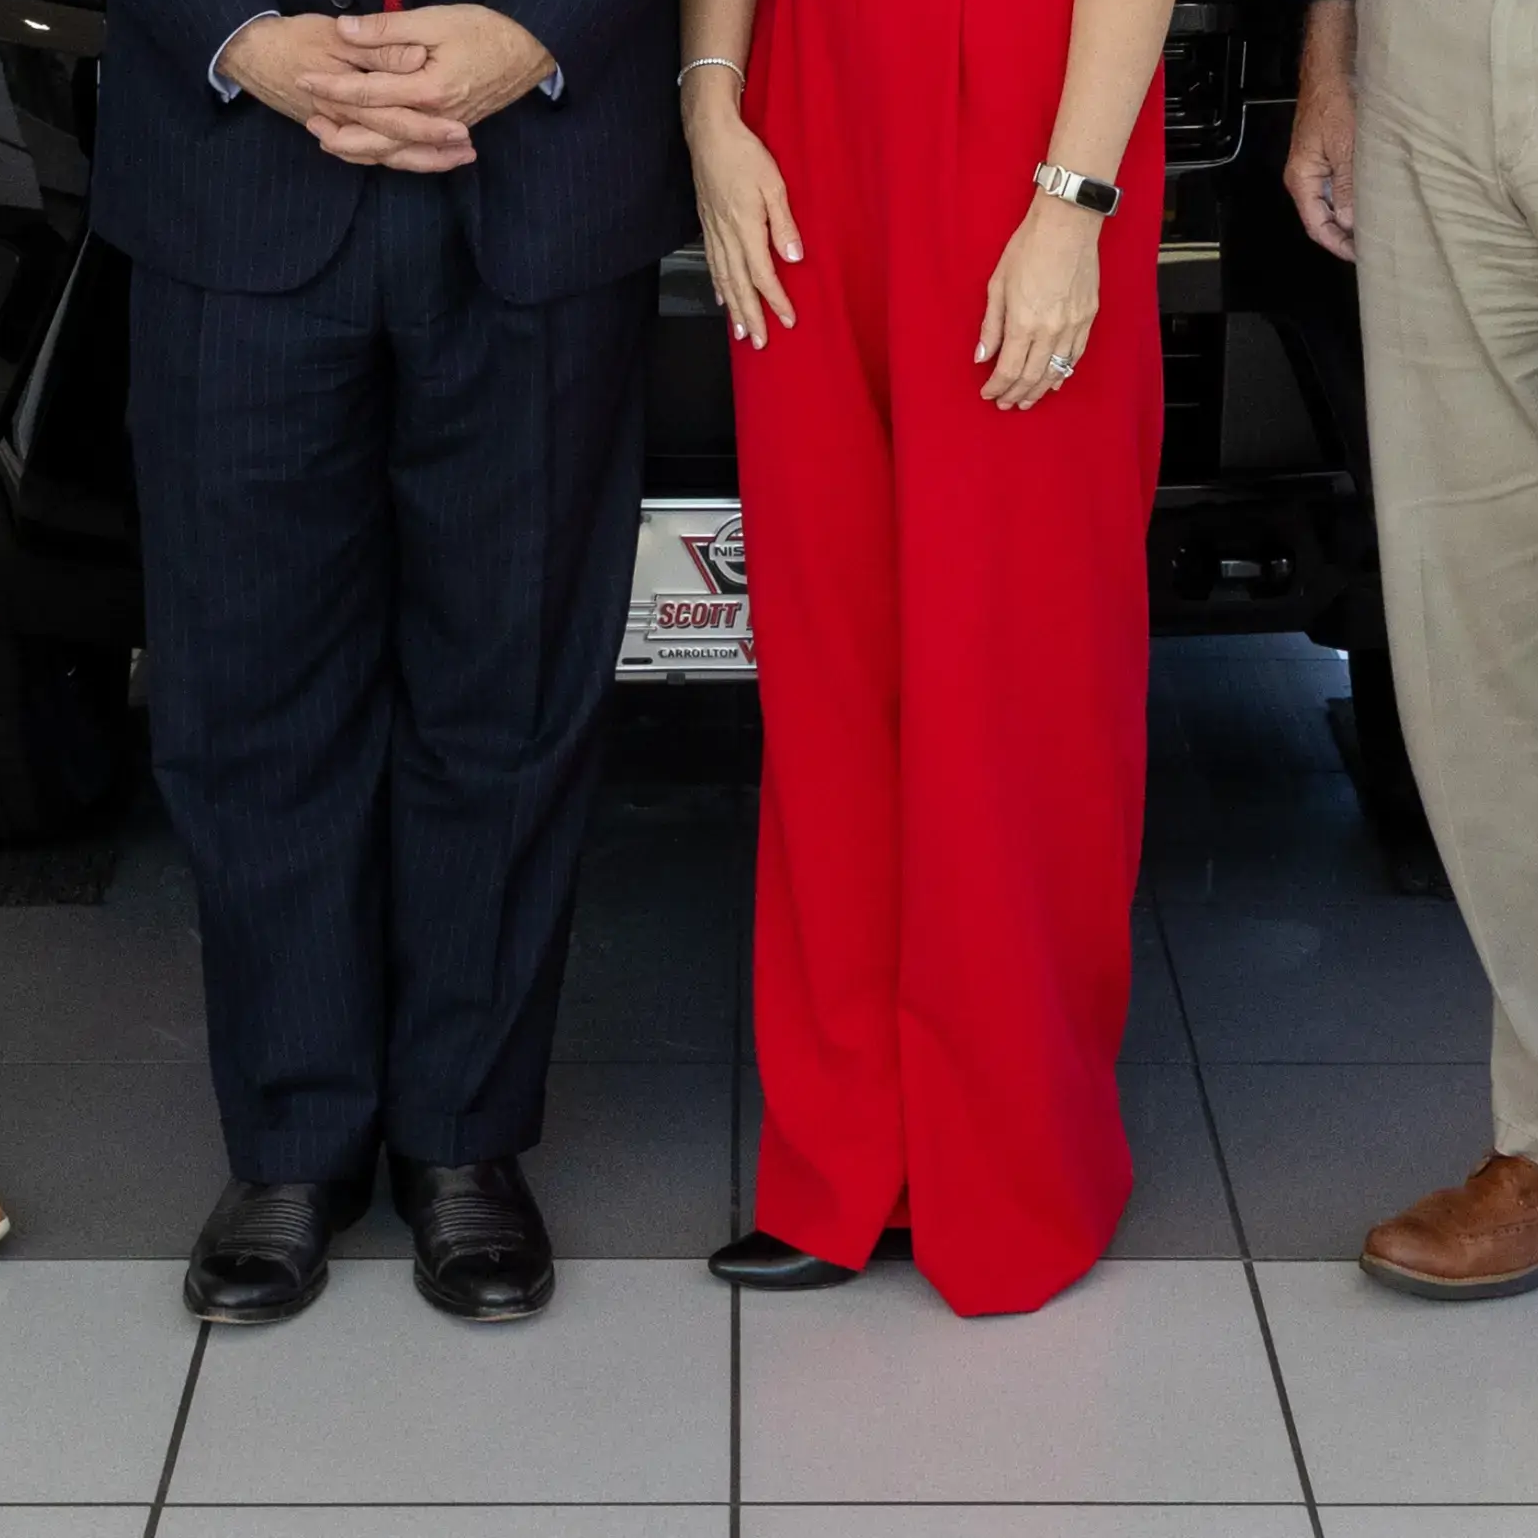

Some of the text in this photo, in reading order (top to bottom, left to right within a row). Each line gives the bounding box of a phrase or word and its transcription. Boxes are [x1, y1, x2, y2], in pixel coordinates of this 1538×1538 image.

[714, 545, 745, 558] NIS
[656, 600, 742, 630] SCOTT
[658, 647, 739, 659] CARROLLTON
